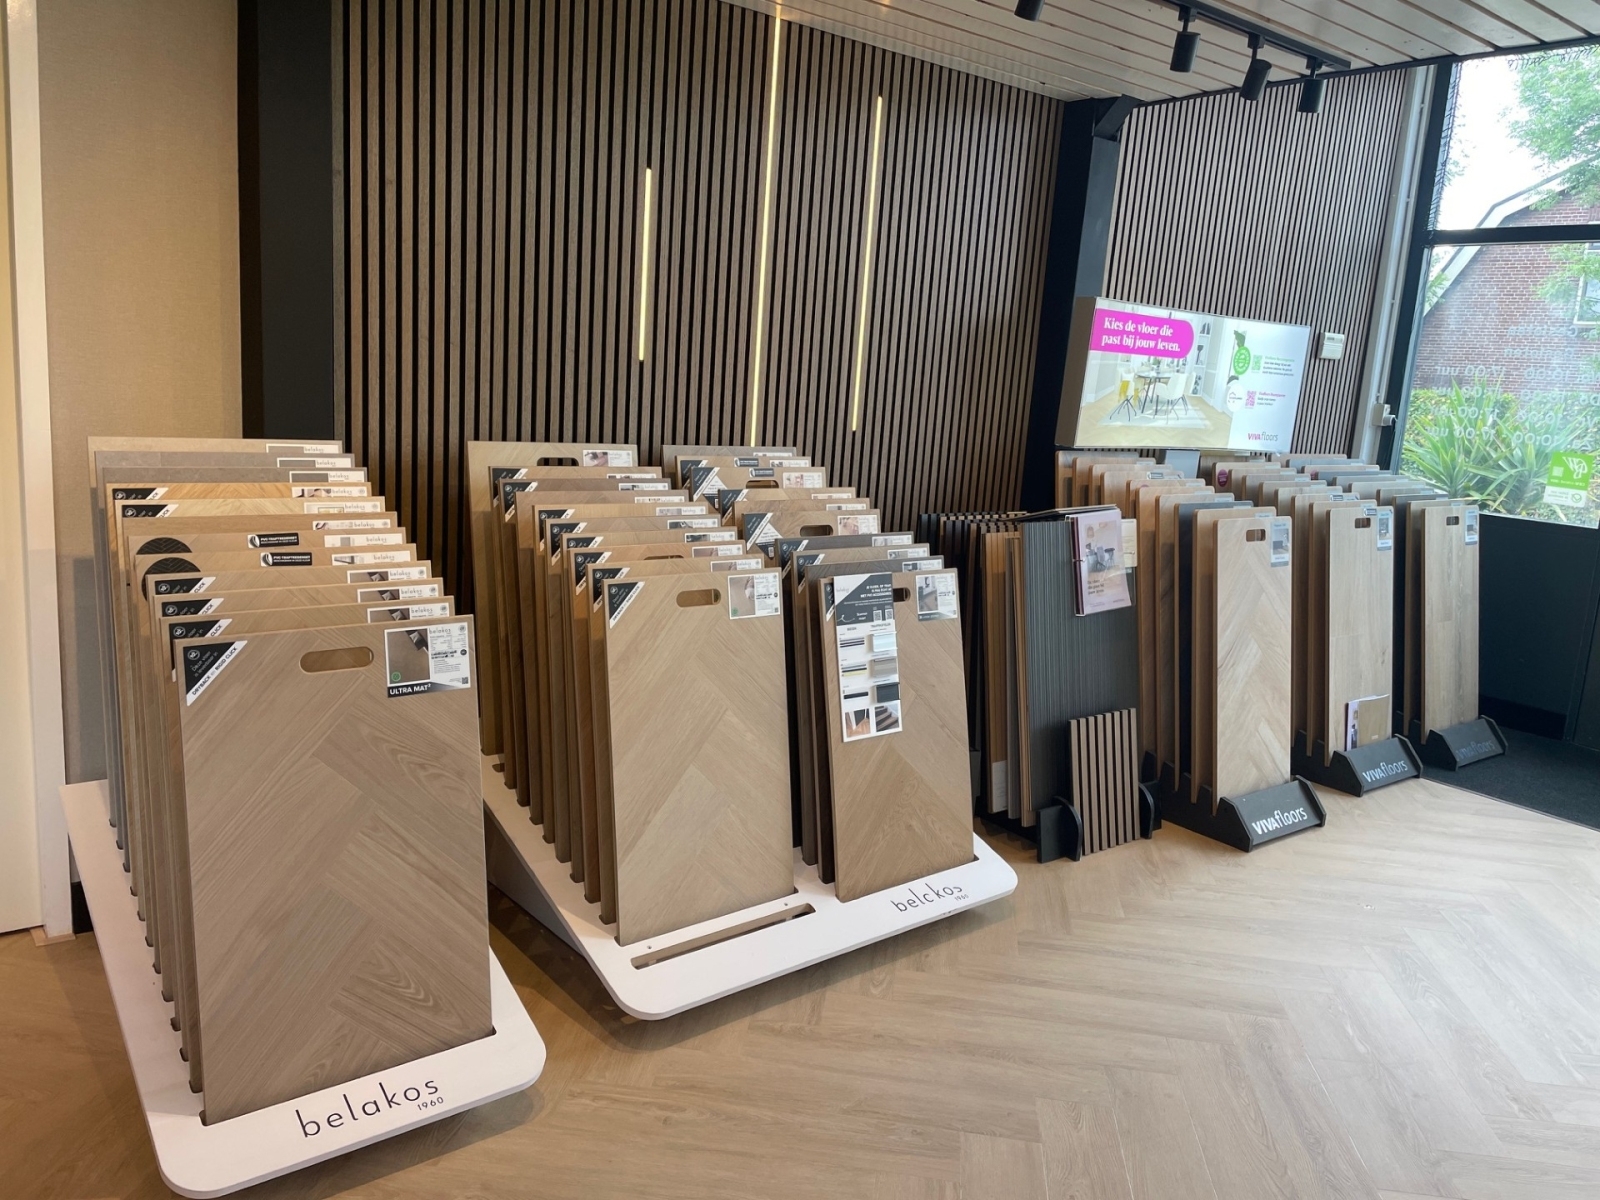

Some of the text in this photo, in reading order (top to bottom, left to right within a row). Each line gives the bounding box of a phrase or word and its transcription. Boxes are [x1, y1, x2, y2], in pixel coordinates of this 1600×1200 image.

[1104, 317, 1173, 336] Kies de vloer die
[1101, 335, 1181, 352] past bij jouw leven.
[429, 627, 451, 635] belakos
[192, 675, 211, 696] DRYBACK
[225, 647, 237, 660] CLICK
[389, 686, 412, 695] ULTRA
[1362, 760, 1408, 782] VIVAfloors
[1251, 807, 1308, 835] VIVAfloors
[295, 1080, 438, 1138] belakos
[417, 1096, 444, 1111] 1960
